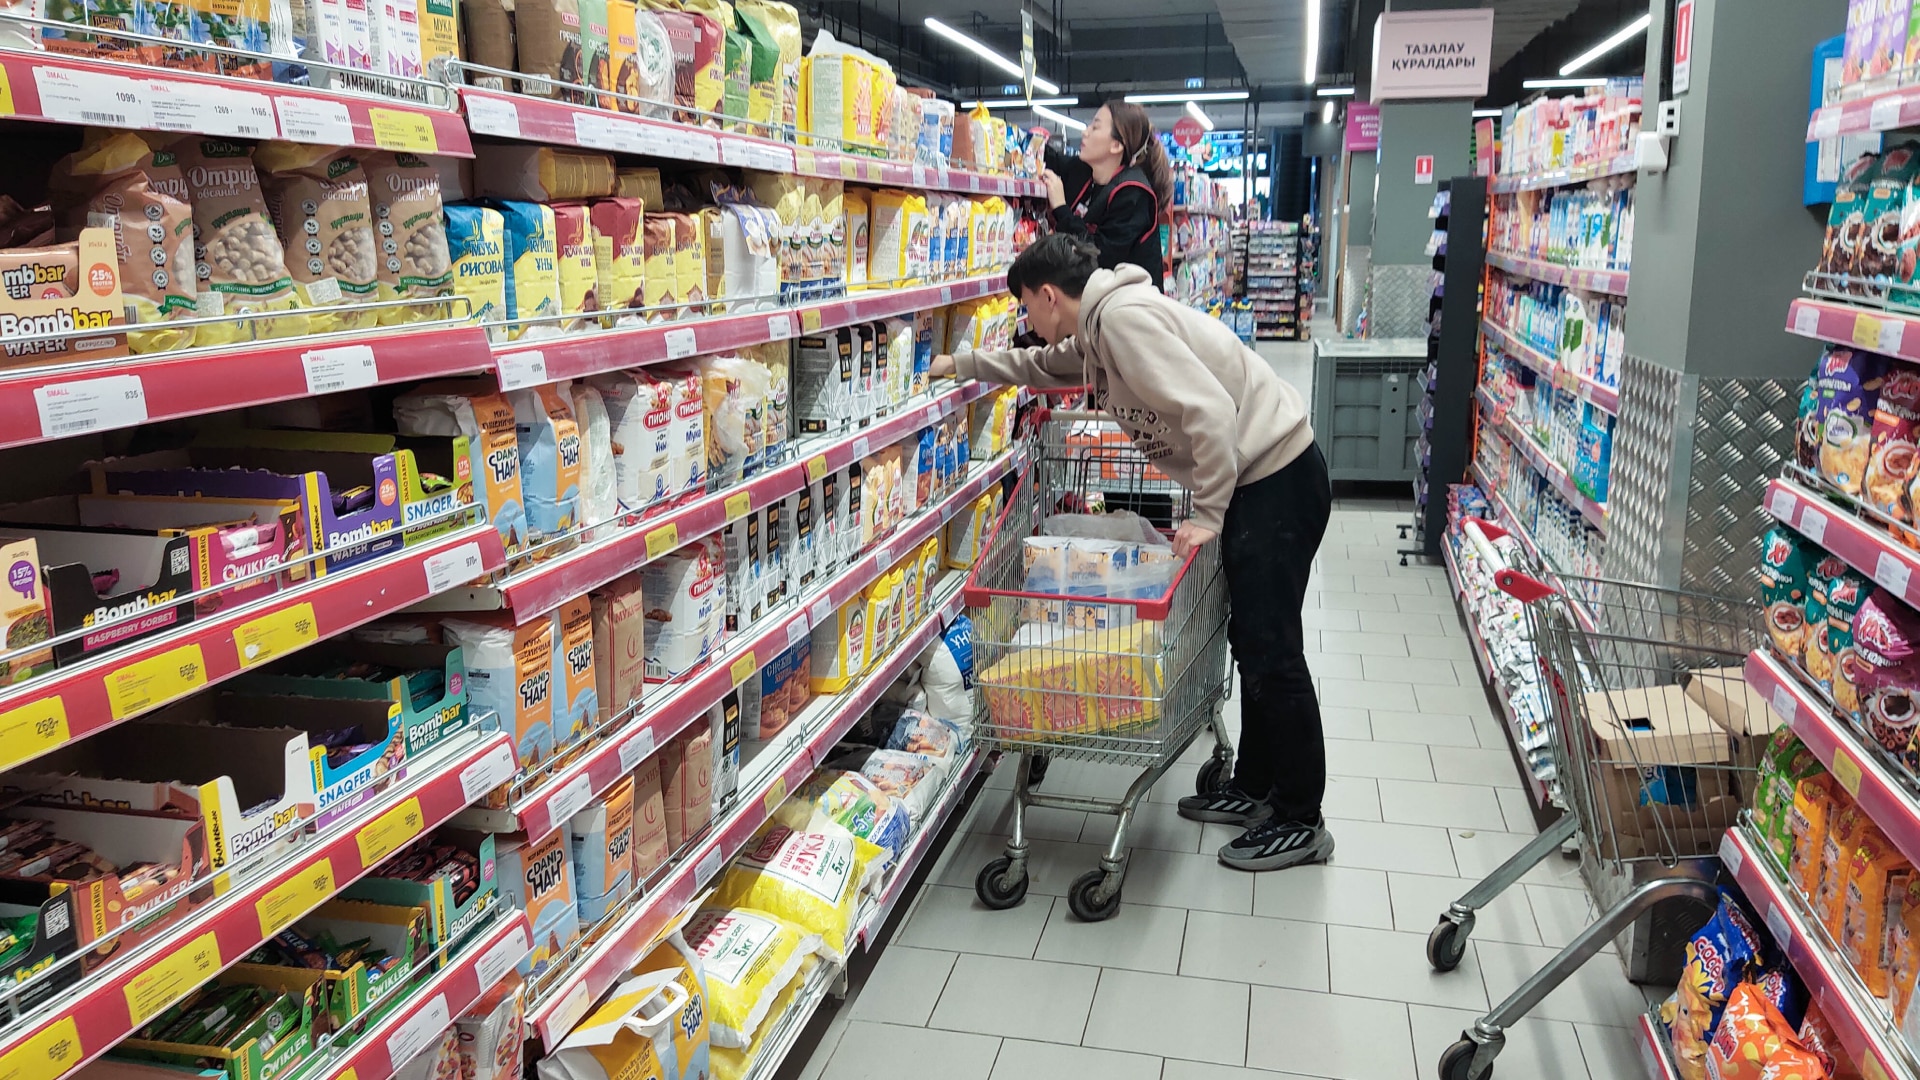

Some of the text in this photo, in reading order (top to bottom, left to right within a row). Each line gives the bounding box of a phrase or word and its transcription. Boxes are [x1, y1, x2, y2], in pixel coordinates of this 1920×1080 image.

[434, 17, 452, 32] МУКА
[1405, 43, 1466, 55] ТАЗАЛАУ
[1392, 56, 1475, 71] ҚҰРАЛДАРЫ
[46, 71, 69, 80] SMALL
[150, 85, 170, 93] SMALL
[340, 72, 397, 97] ЗАМЕНИТЕЛЬ
[116, 92, 136, 103] 1099
[470, 240, 500, 257] МУКА
[91, 269, 113, 281] 25%
[0, 308, 113, 337] Bombbar
[46, 388, 69, 397] SMALL
[686, 430, 702, 444] Мука
[497, 448, 514, 461] DANI
[329, 517, 395, 550] Bombbar
[331, 543, 368, 562] WAFER
[12, 566, 32, 581] 15%
[87, 610, 174, 646] RASPBERRY SORBET
[573, 644, 589, 658] DANI
[526, 672, 546, 689] DANI
[409, 703, 461, 743] Bombbar
[410, 727, 440, 752] WAFER
[230, 806, 296, 849] Bombbar
[852, 814, 868, 832] 5
[613, 827, 630, 845] DANI
[533, 849, 559, 876] DANI
[366, 963, 412, 1003] QWIKLER
[684, 995, 700, 1020] DANI
[260, 1033, 309, 1080] QWIKLER
